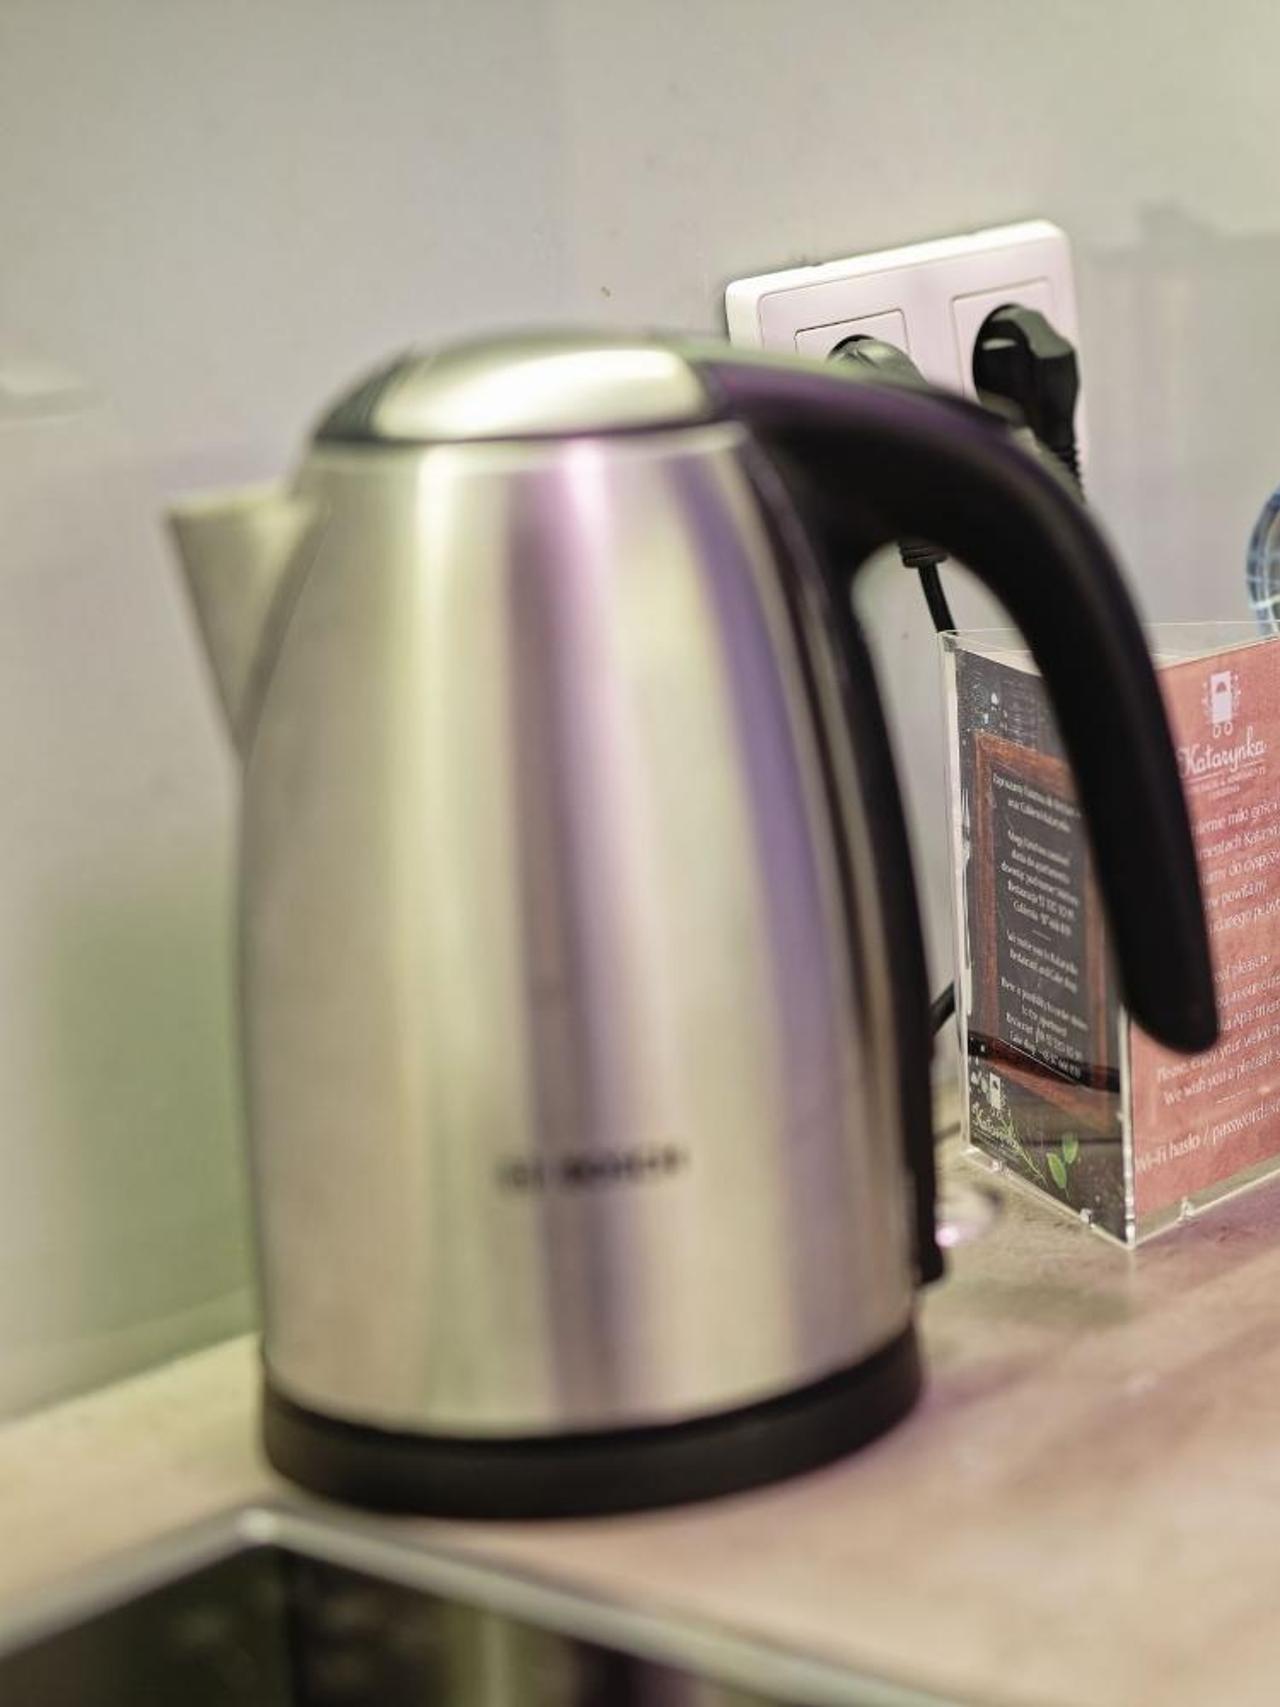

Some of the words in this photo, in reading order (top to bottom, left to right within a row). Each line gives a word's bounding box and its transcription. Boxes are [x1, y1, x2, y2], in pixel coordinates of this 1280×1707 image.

[1178, 725, 1268, 777] Katarynka
[1163, 1088, 1181, 1106] We
[1183, 1077, 1206, 1097] wish
